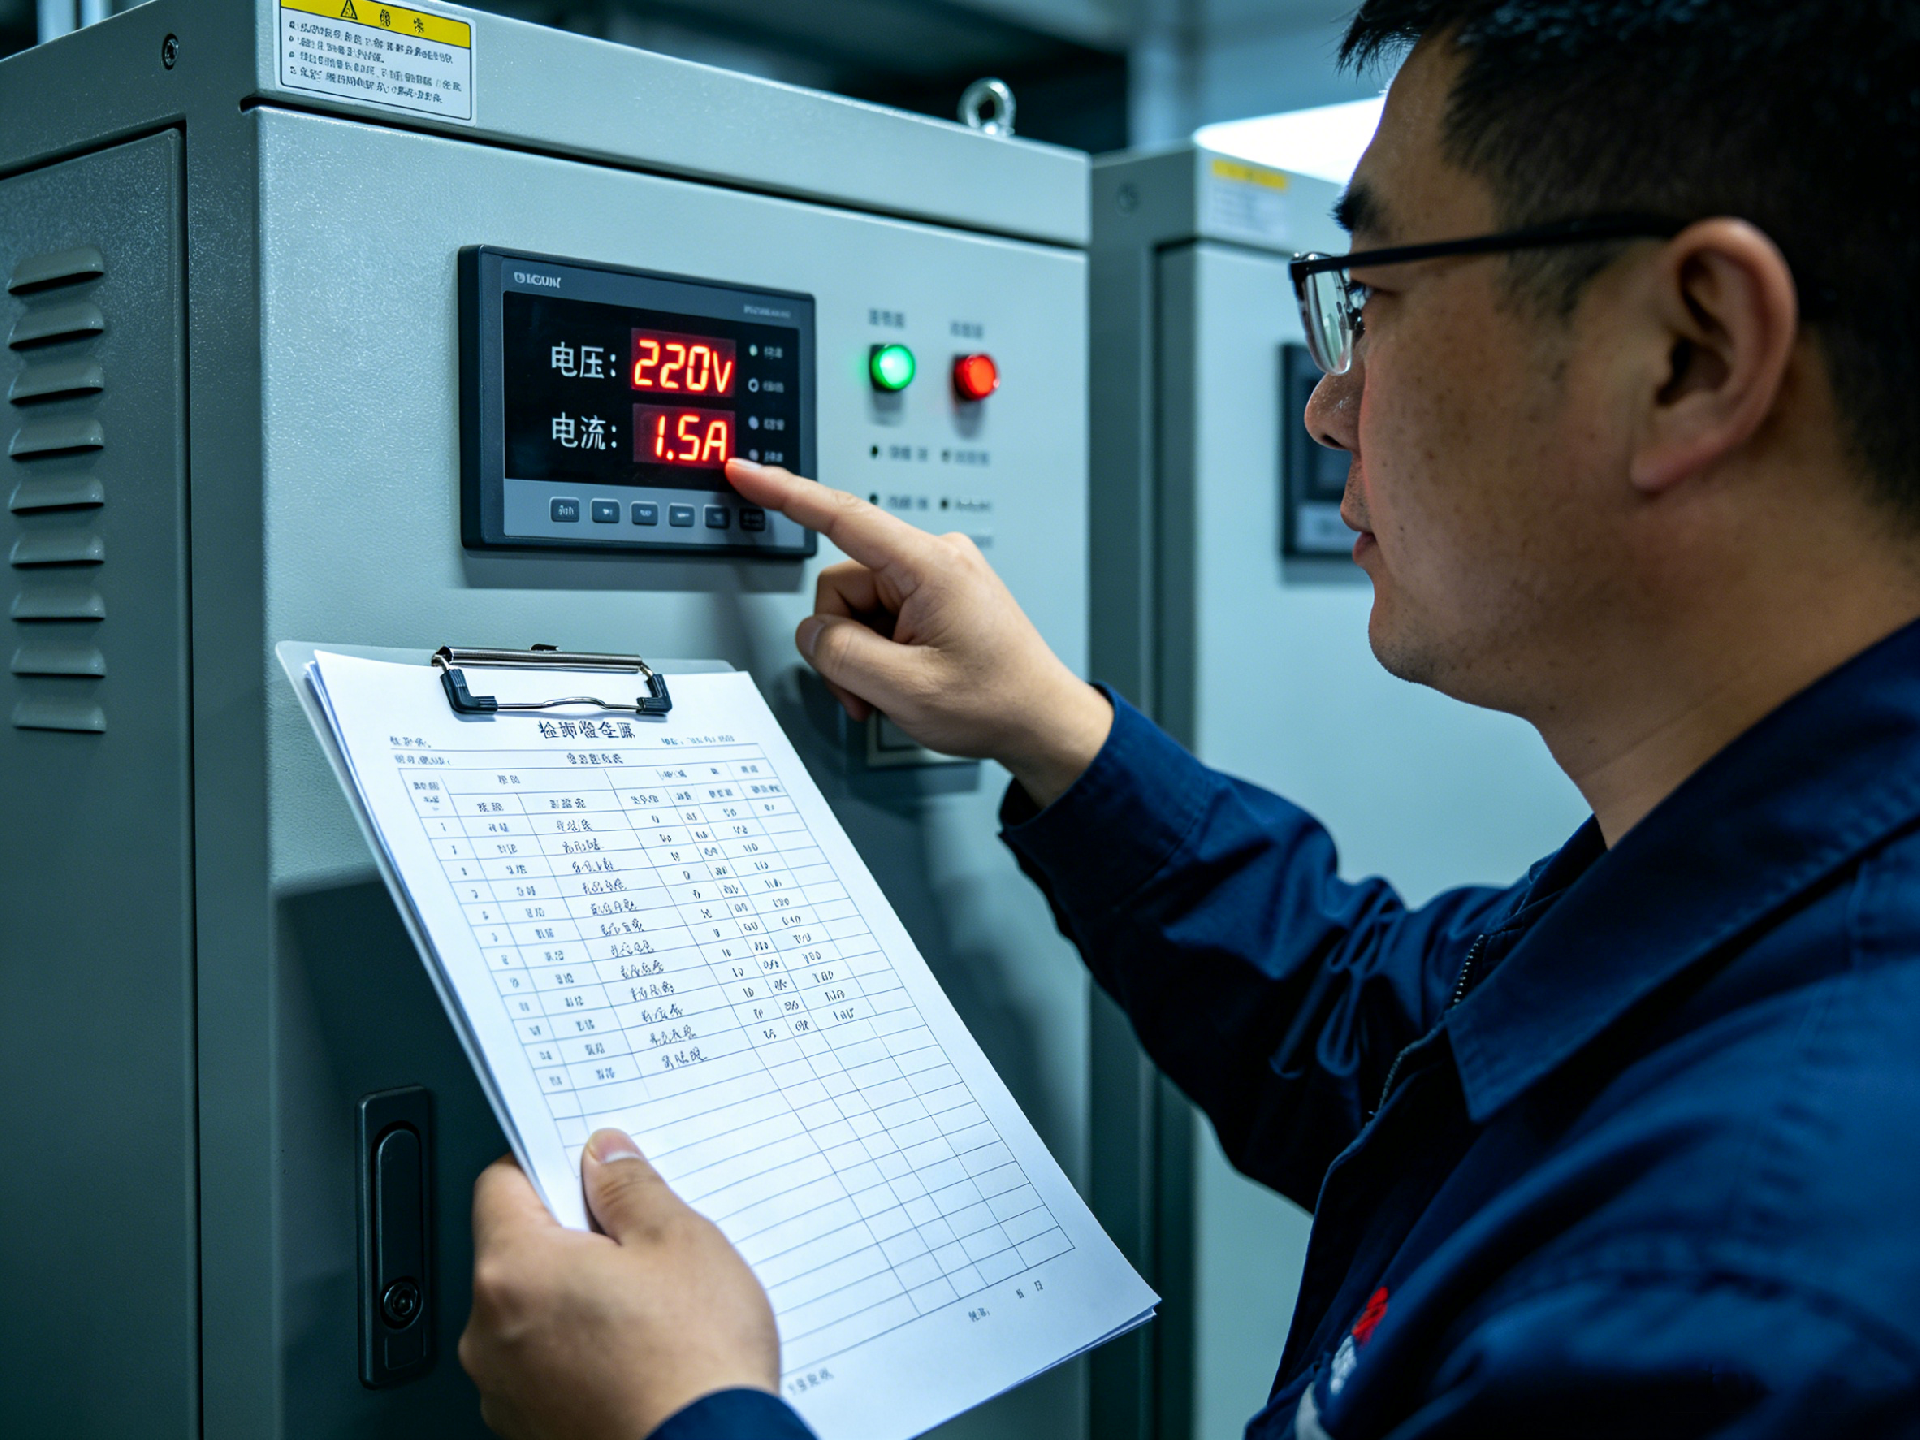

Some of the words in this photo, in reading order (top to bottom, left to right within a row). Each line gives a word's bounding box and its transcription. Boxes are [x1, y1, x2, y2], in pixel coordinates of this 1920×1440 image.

[552, 341, 616, 379] 电压：
[634, 339, 733, 394] 220V
[552, 411, 618, 450] 电流：
[655, 414, 728, 463] 1.5A
